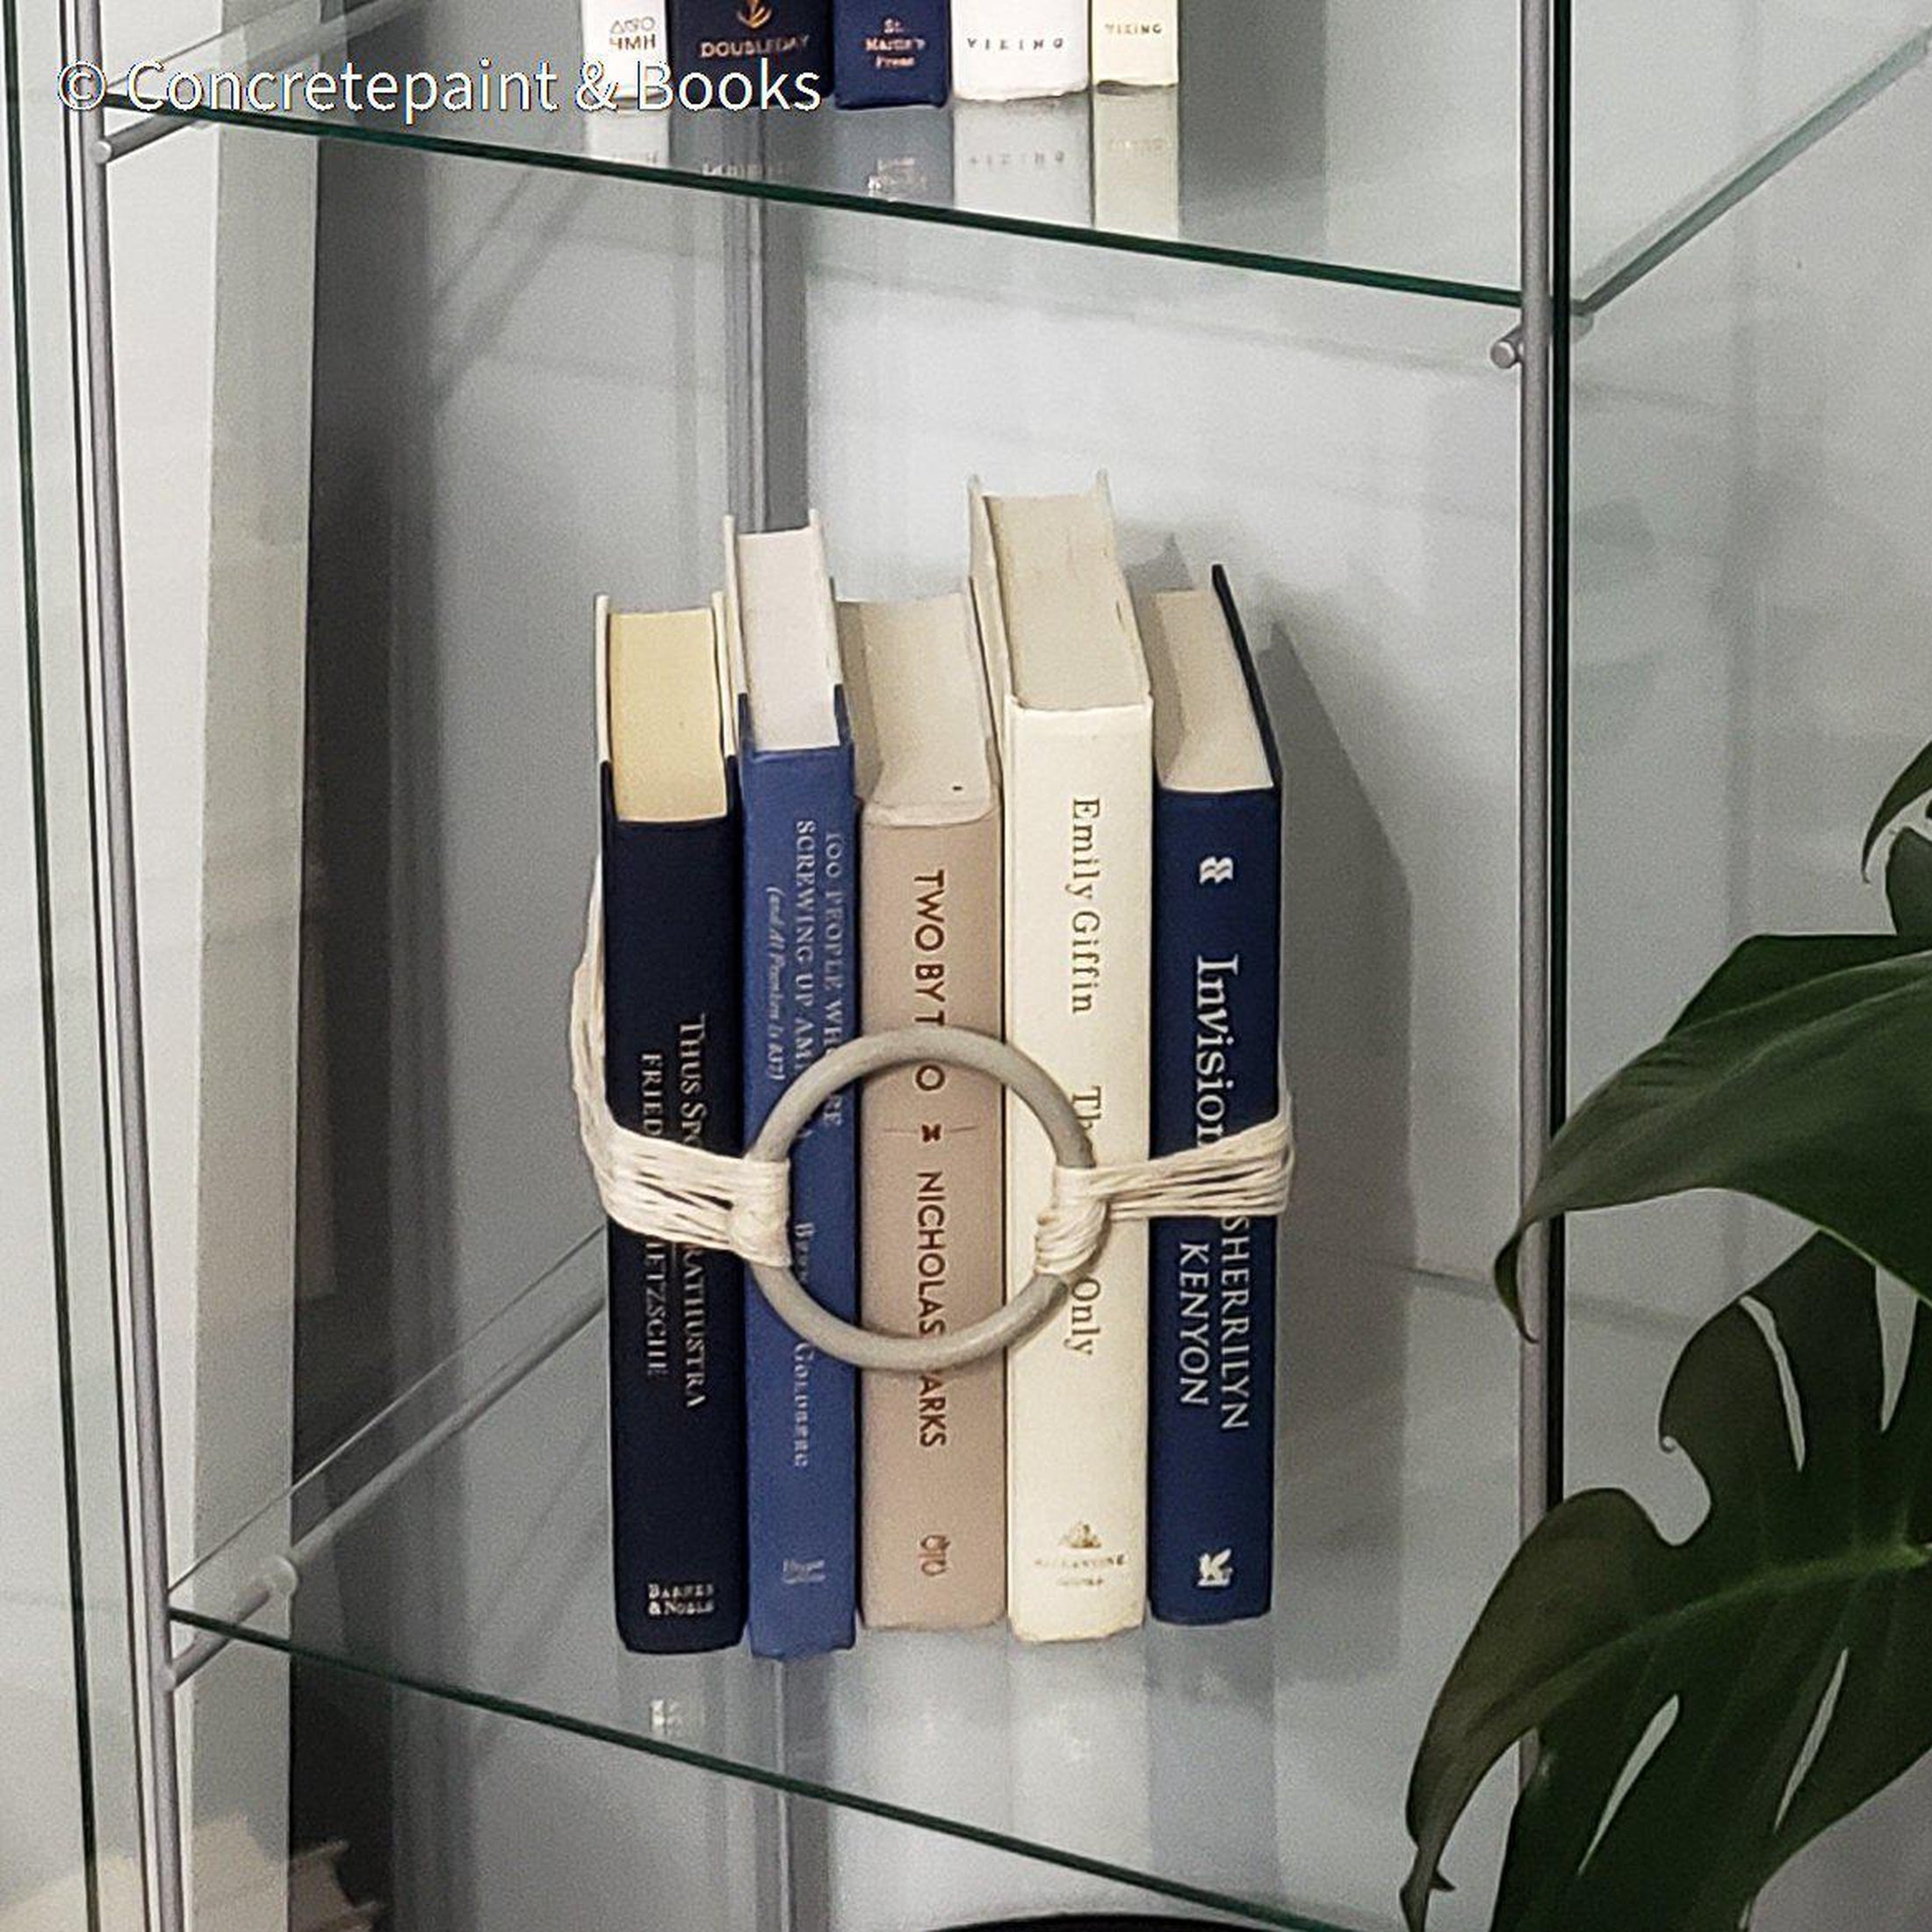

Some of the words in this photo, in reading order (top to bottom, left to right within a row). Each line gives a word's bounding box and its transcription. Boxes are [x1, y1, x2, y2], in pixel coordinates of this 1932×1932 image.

[1064, 797, 1101, 900] Emily
[795, 819, 817, 963] SCREWING
[913, 869, 946, 952] TWO
[794, 972, 815, 1007] UP
[914, 962, 947, 1003] BY
[1071, 910, 1101, 1014] Giffin
[823, 998, 843, 1048] WH
[914, 1010, 947, 1092] TO
[642, 1052, 664, 1136] FRIED
[1071, 1085, 1102, 1135] Th
[916, 1170, 948, 1337] NICHOLAS
[645, 1241, 668, 1377] IETZSCHE
[1063, 1276, 1102, 1356] Only
[1179, 1242, 1211, 1406] KENYON
[1220, 1216, 1250, 1429] SHERRILYN
[918, 1372, 947, 1447] ARKS
